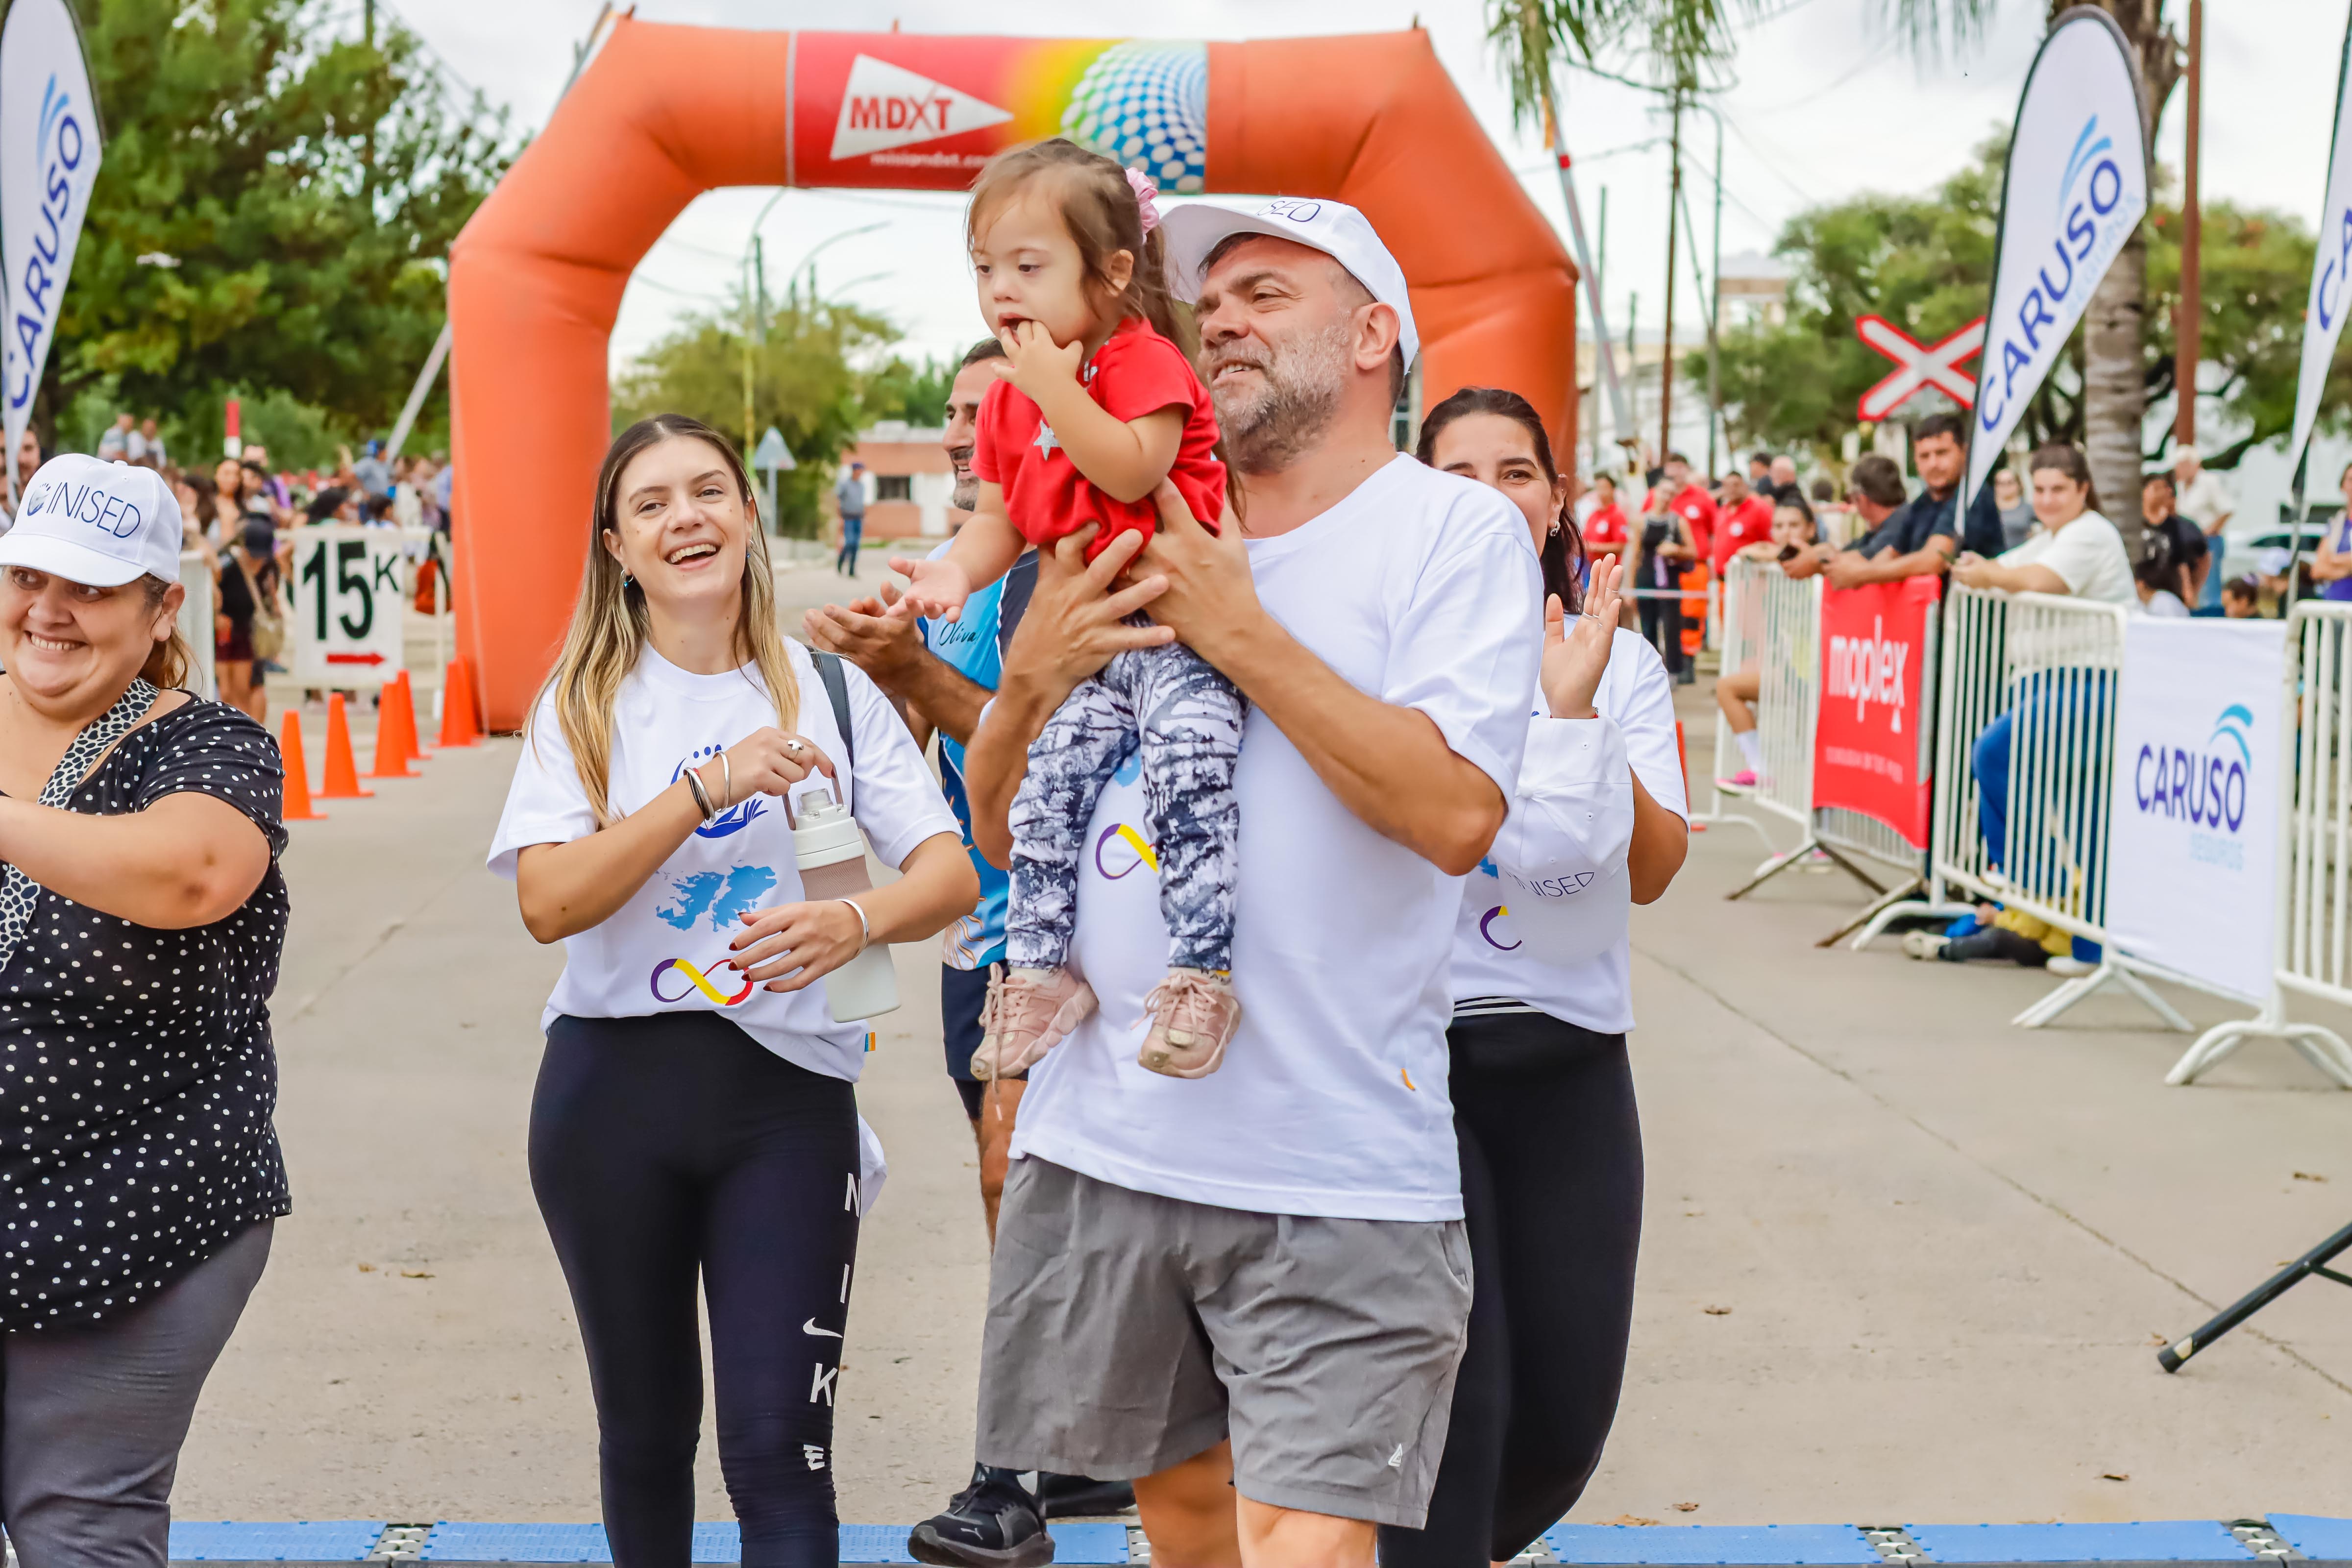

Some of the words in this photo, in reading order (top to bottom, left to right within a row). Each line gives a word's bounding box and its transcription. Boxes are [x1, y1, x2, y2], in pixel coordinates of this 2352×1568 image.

[851, 86, 952, 134] MDXT
[3, 115, 82, 409] CARUSO
[1979, 158, 2122, 432] CARUSO
[1828, 614, 1909, 723] moplex
[2135, 743, 2246, 833] CARUSO
[803, 1172, 861, 1470] NIKE
